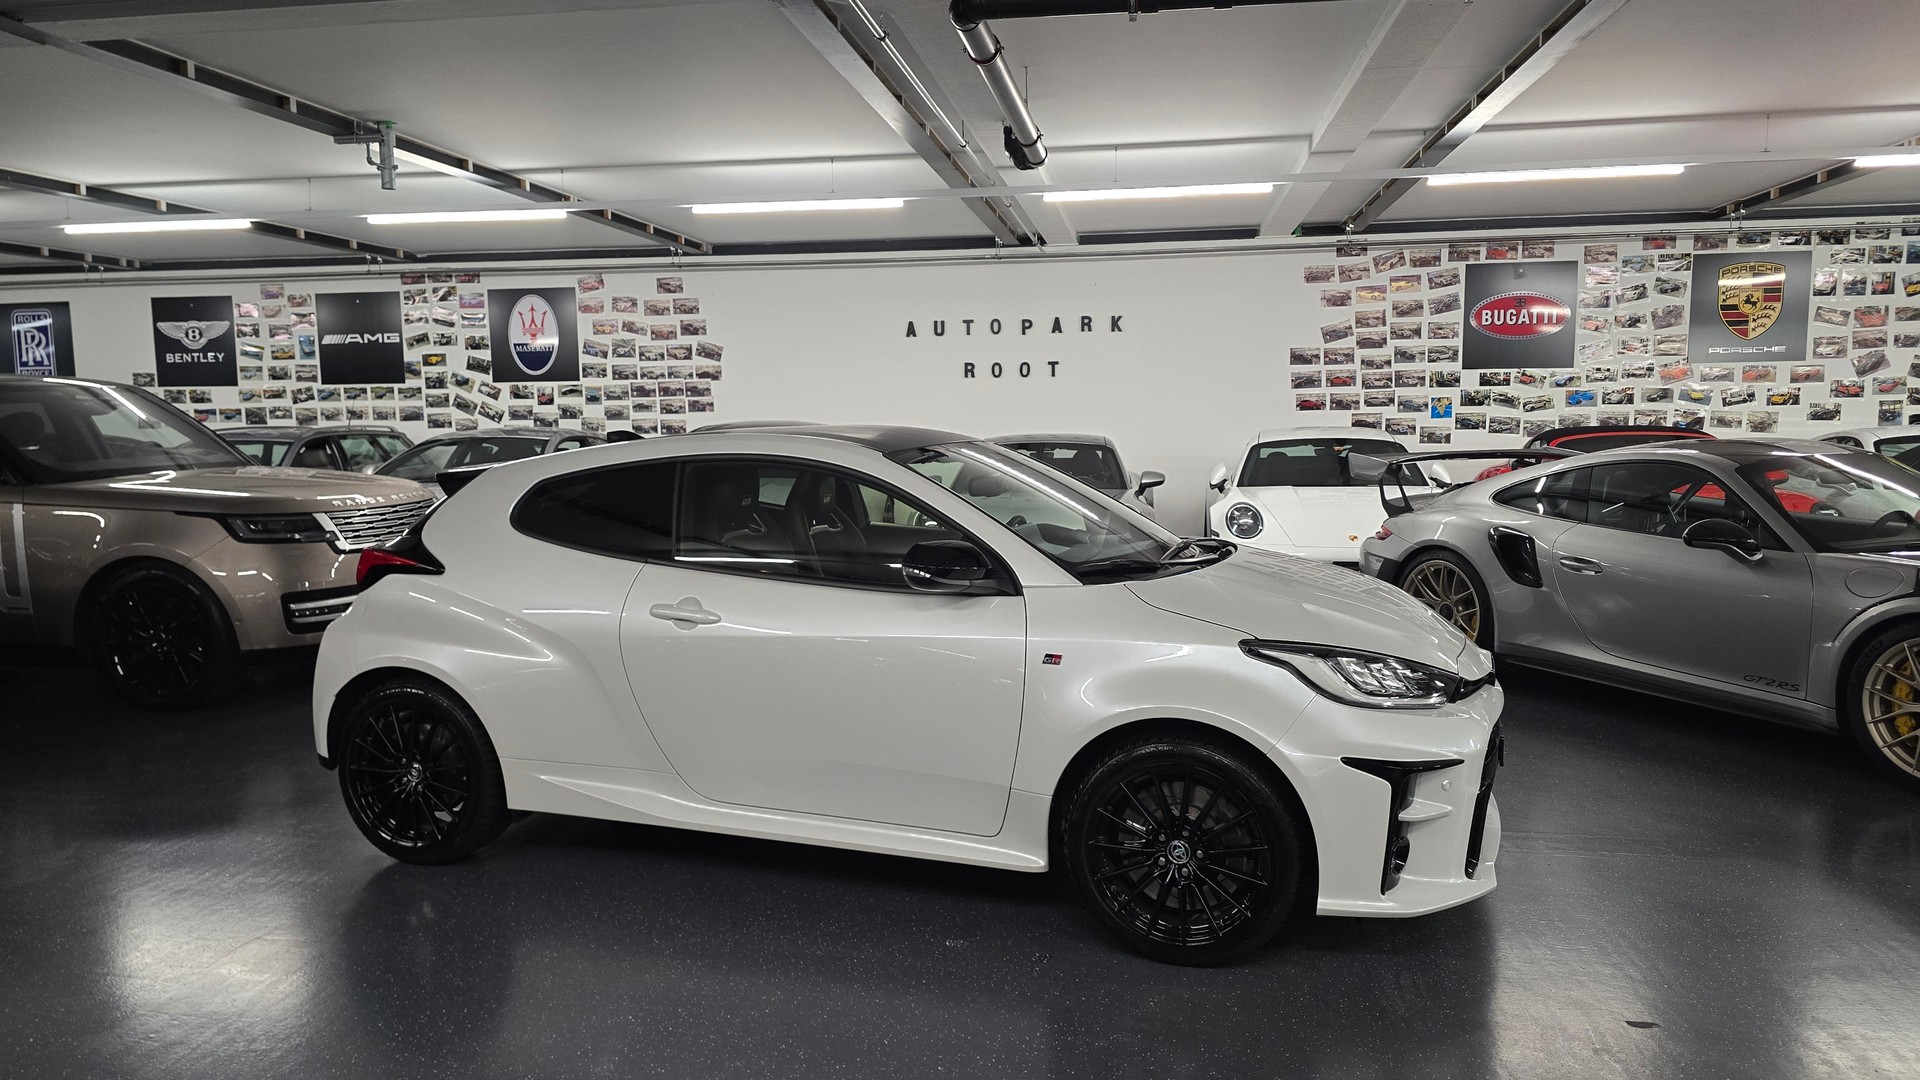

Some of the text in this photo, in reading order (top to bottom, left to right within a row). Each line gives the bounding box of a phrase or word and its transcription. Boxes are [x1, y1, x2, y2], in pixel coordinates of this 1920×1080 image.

[1721, 265, 1783, 277] PORSCHE
[17, 314, 47, 324] ROLLS
[1481, 308, 1558, 326] BUGATTI
[344, 333, 400, 344] AMG
[515, 344, 553, 352] MASERATI
[1708, 345, 1786, 354] PORSCHE
[165, 352, 225, 363] BENTLEY
[963, 361, 1060, 379] ROOT
[1043, 656, 1061, 664] GR
